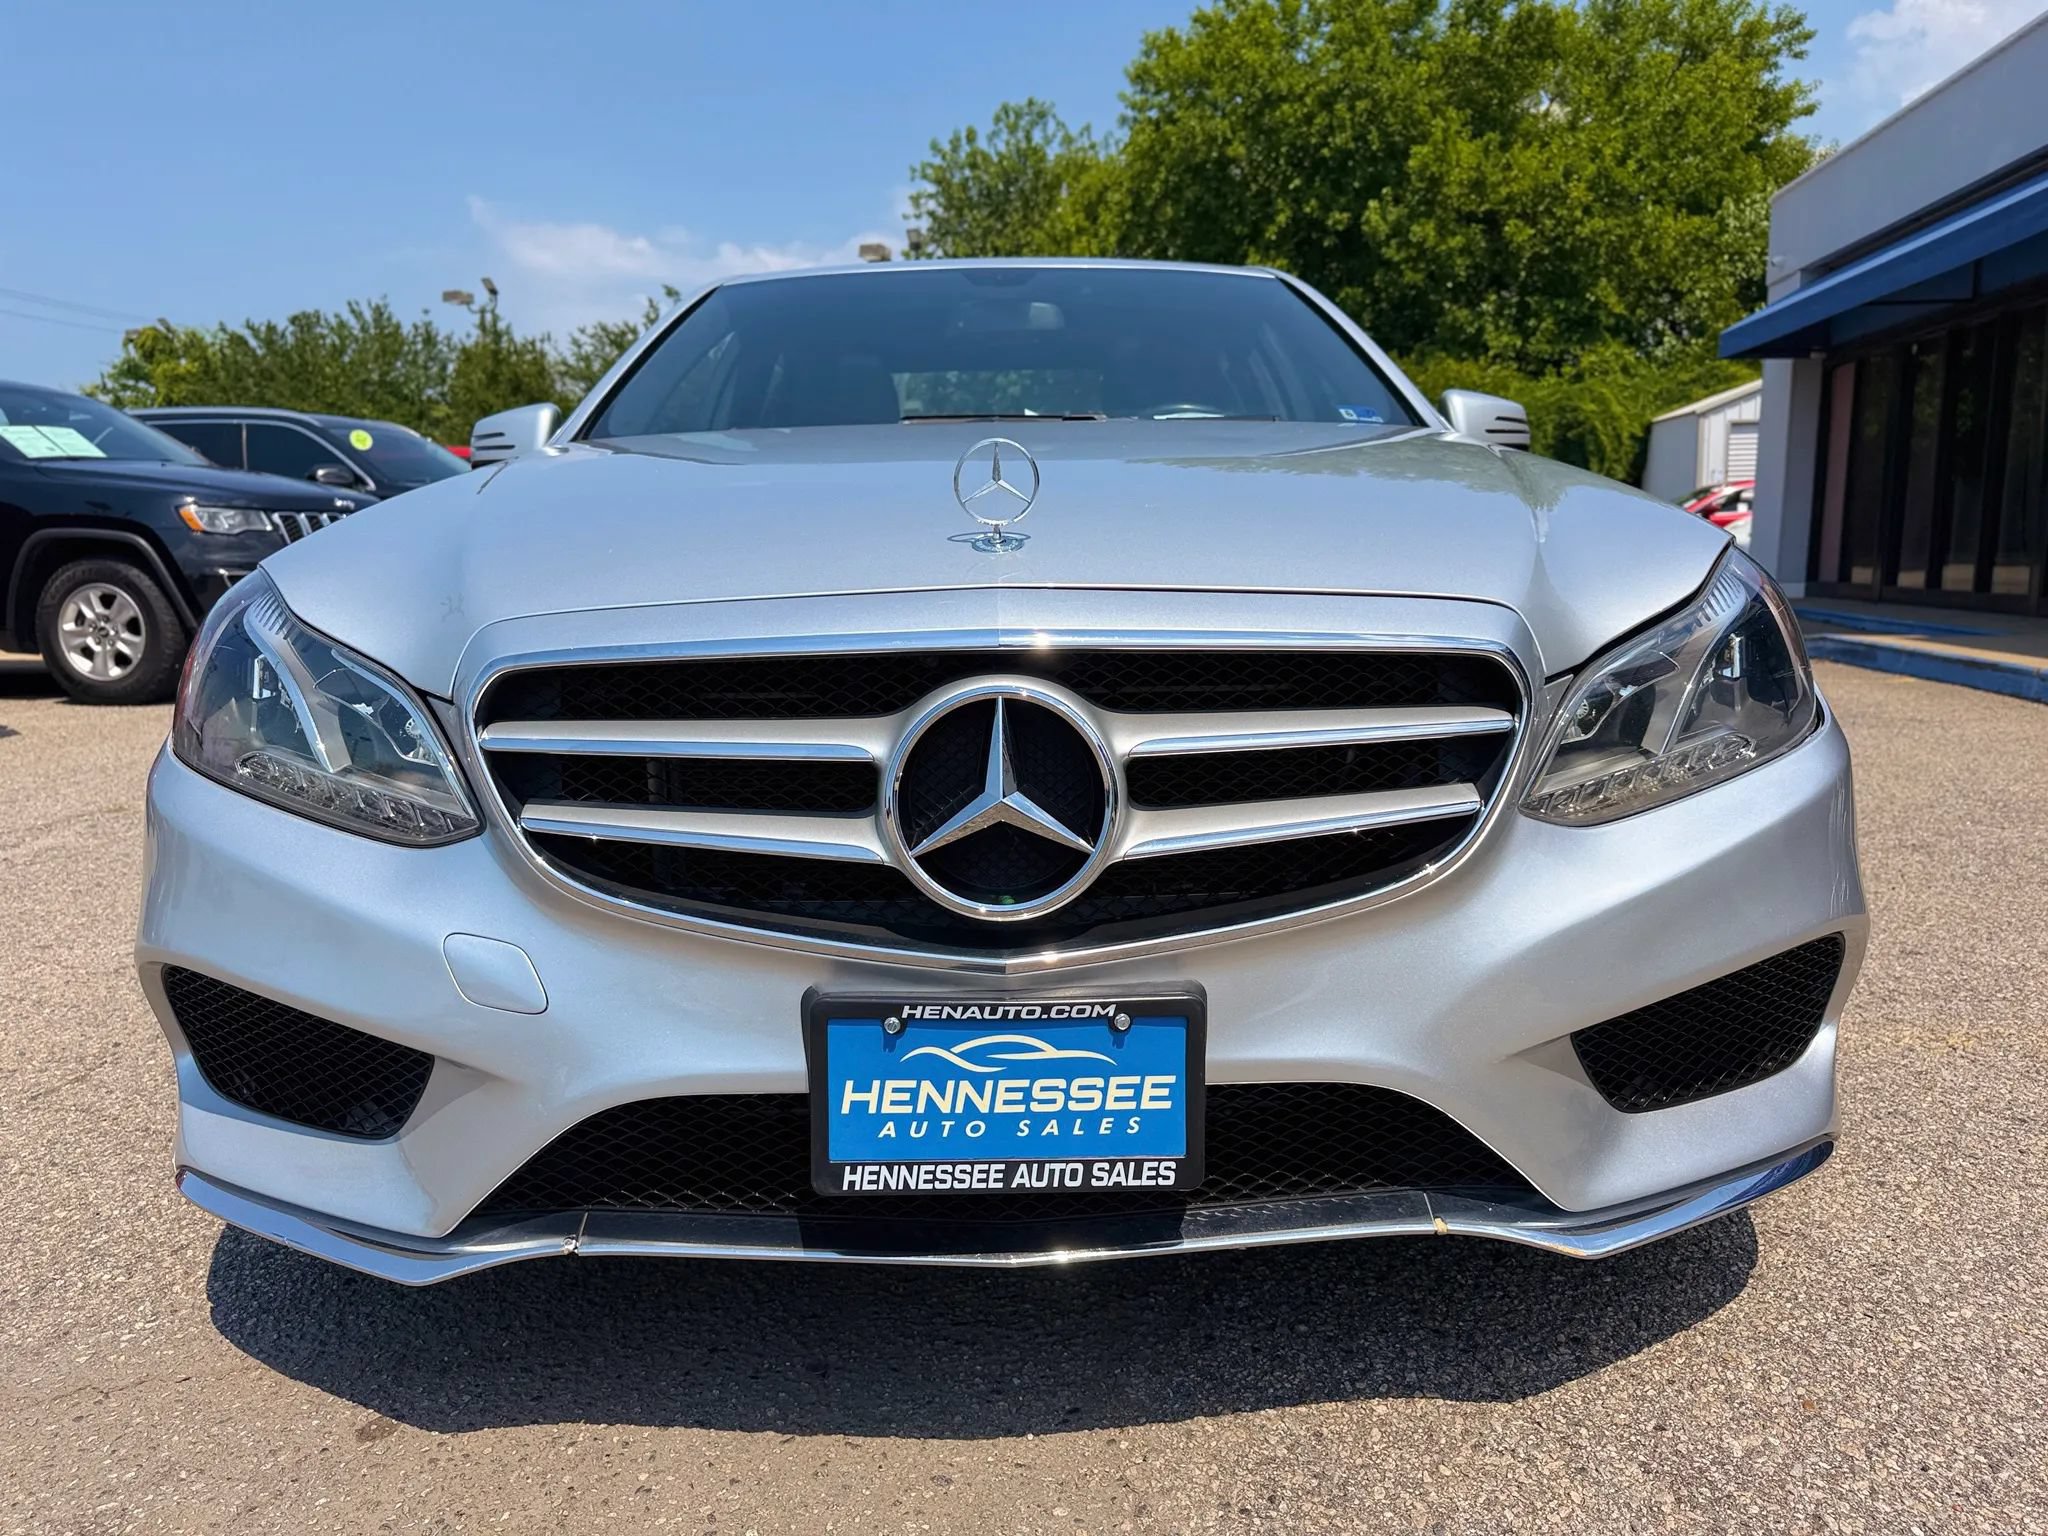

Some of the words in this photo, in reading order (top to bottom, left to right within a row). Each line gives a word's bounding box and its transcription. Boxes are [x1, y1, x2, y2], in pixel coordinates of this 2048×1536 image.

[901, 1004, 1117, 1019] HENAUTO.COM
[841, 1075, 1177, 1114] HENNESSEE
[877, 1120, 986, 1138] AUTO
[1016, 1117, 1142, 1136] SALES
[842, 1163, 1006, 1191] HENNESSEE
[1010, 1161, 1085, 1189] AUTO
[1090, 1160, 1177, 1186] SALES
